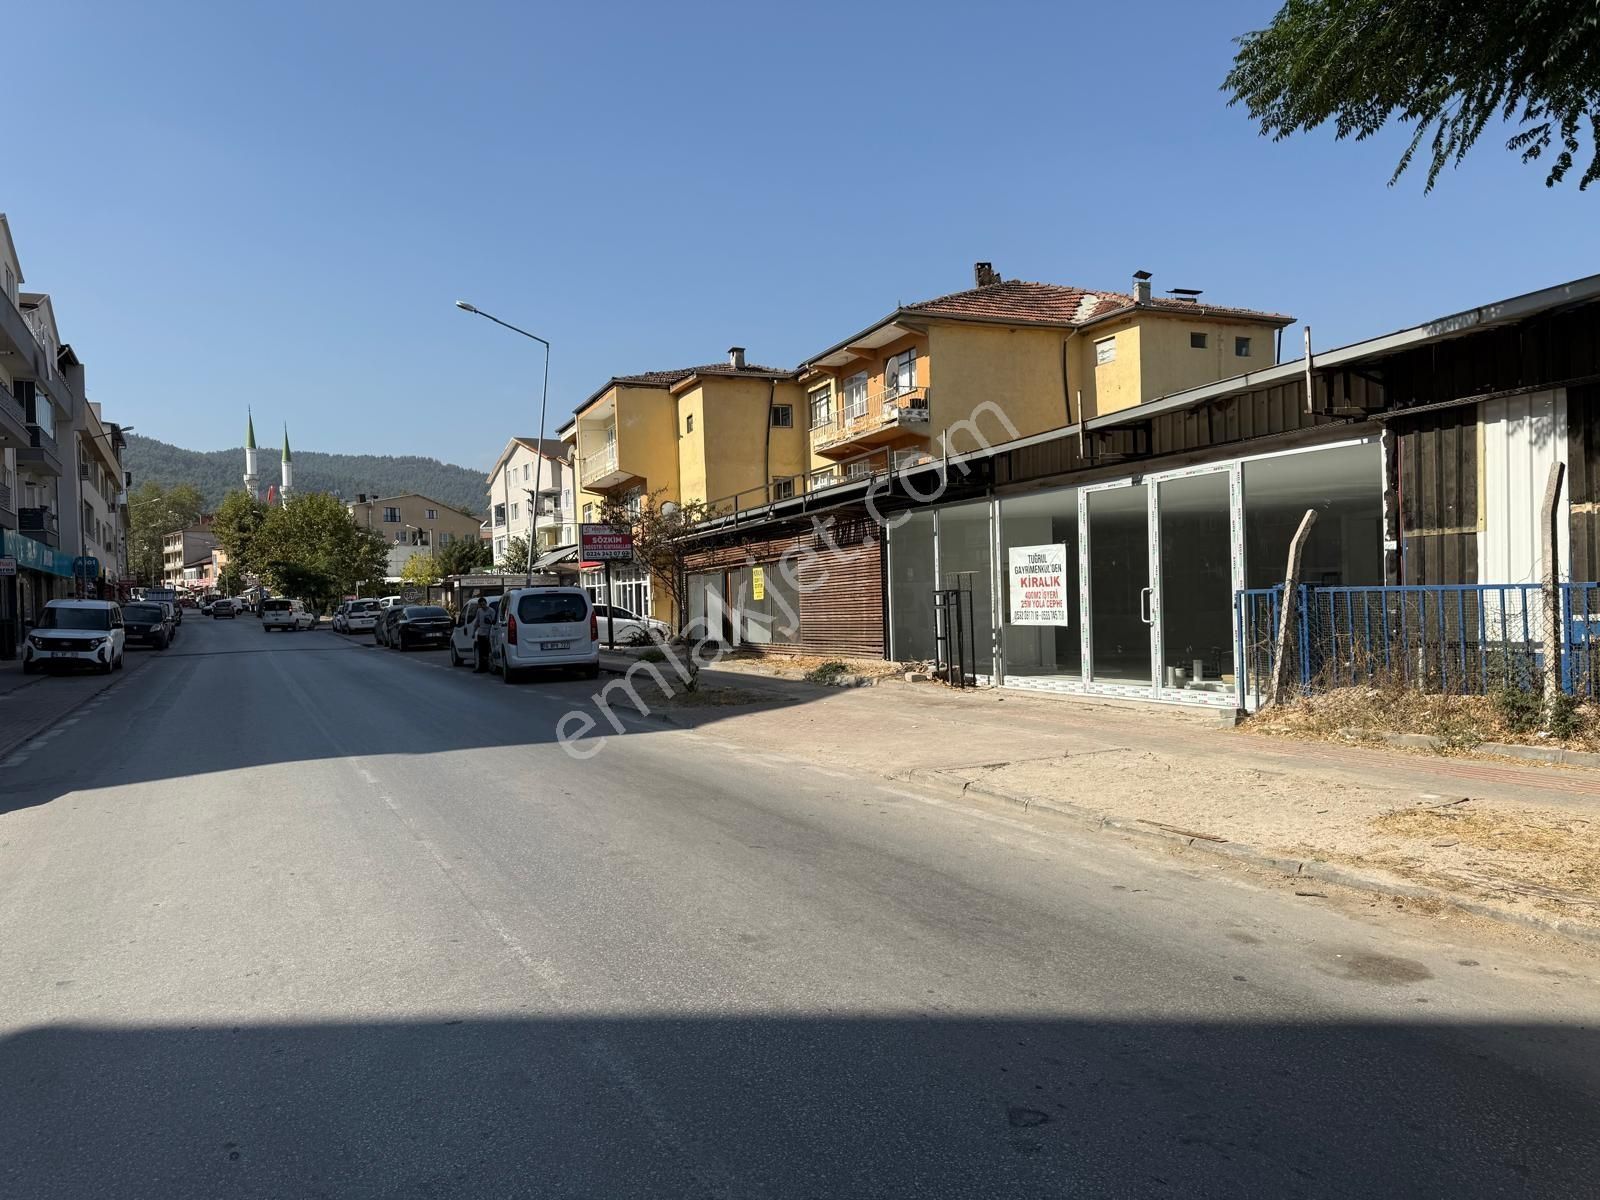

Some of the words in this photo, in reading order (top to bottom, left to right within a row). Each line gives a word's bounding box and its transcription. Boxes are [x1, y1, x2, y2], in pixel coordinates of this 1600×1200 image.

[592, 536, 622, 544] SÖZKİM
[1027, 553, 1047, 564] TUĞRUL
[1020, 575, 1061, 588] KİRALIK
[1032, 600, 1045, 608] YOLA
